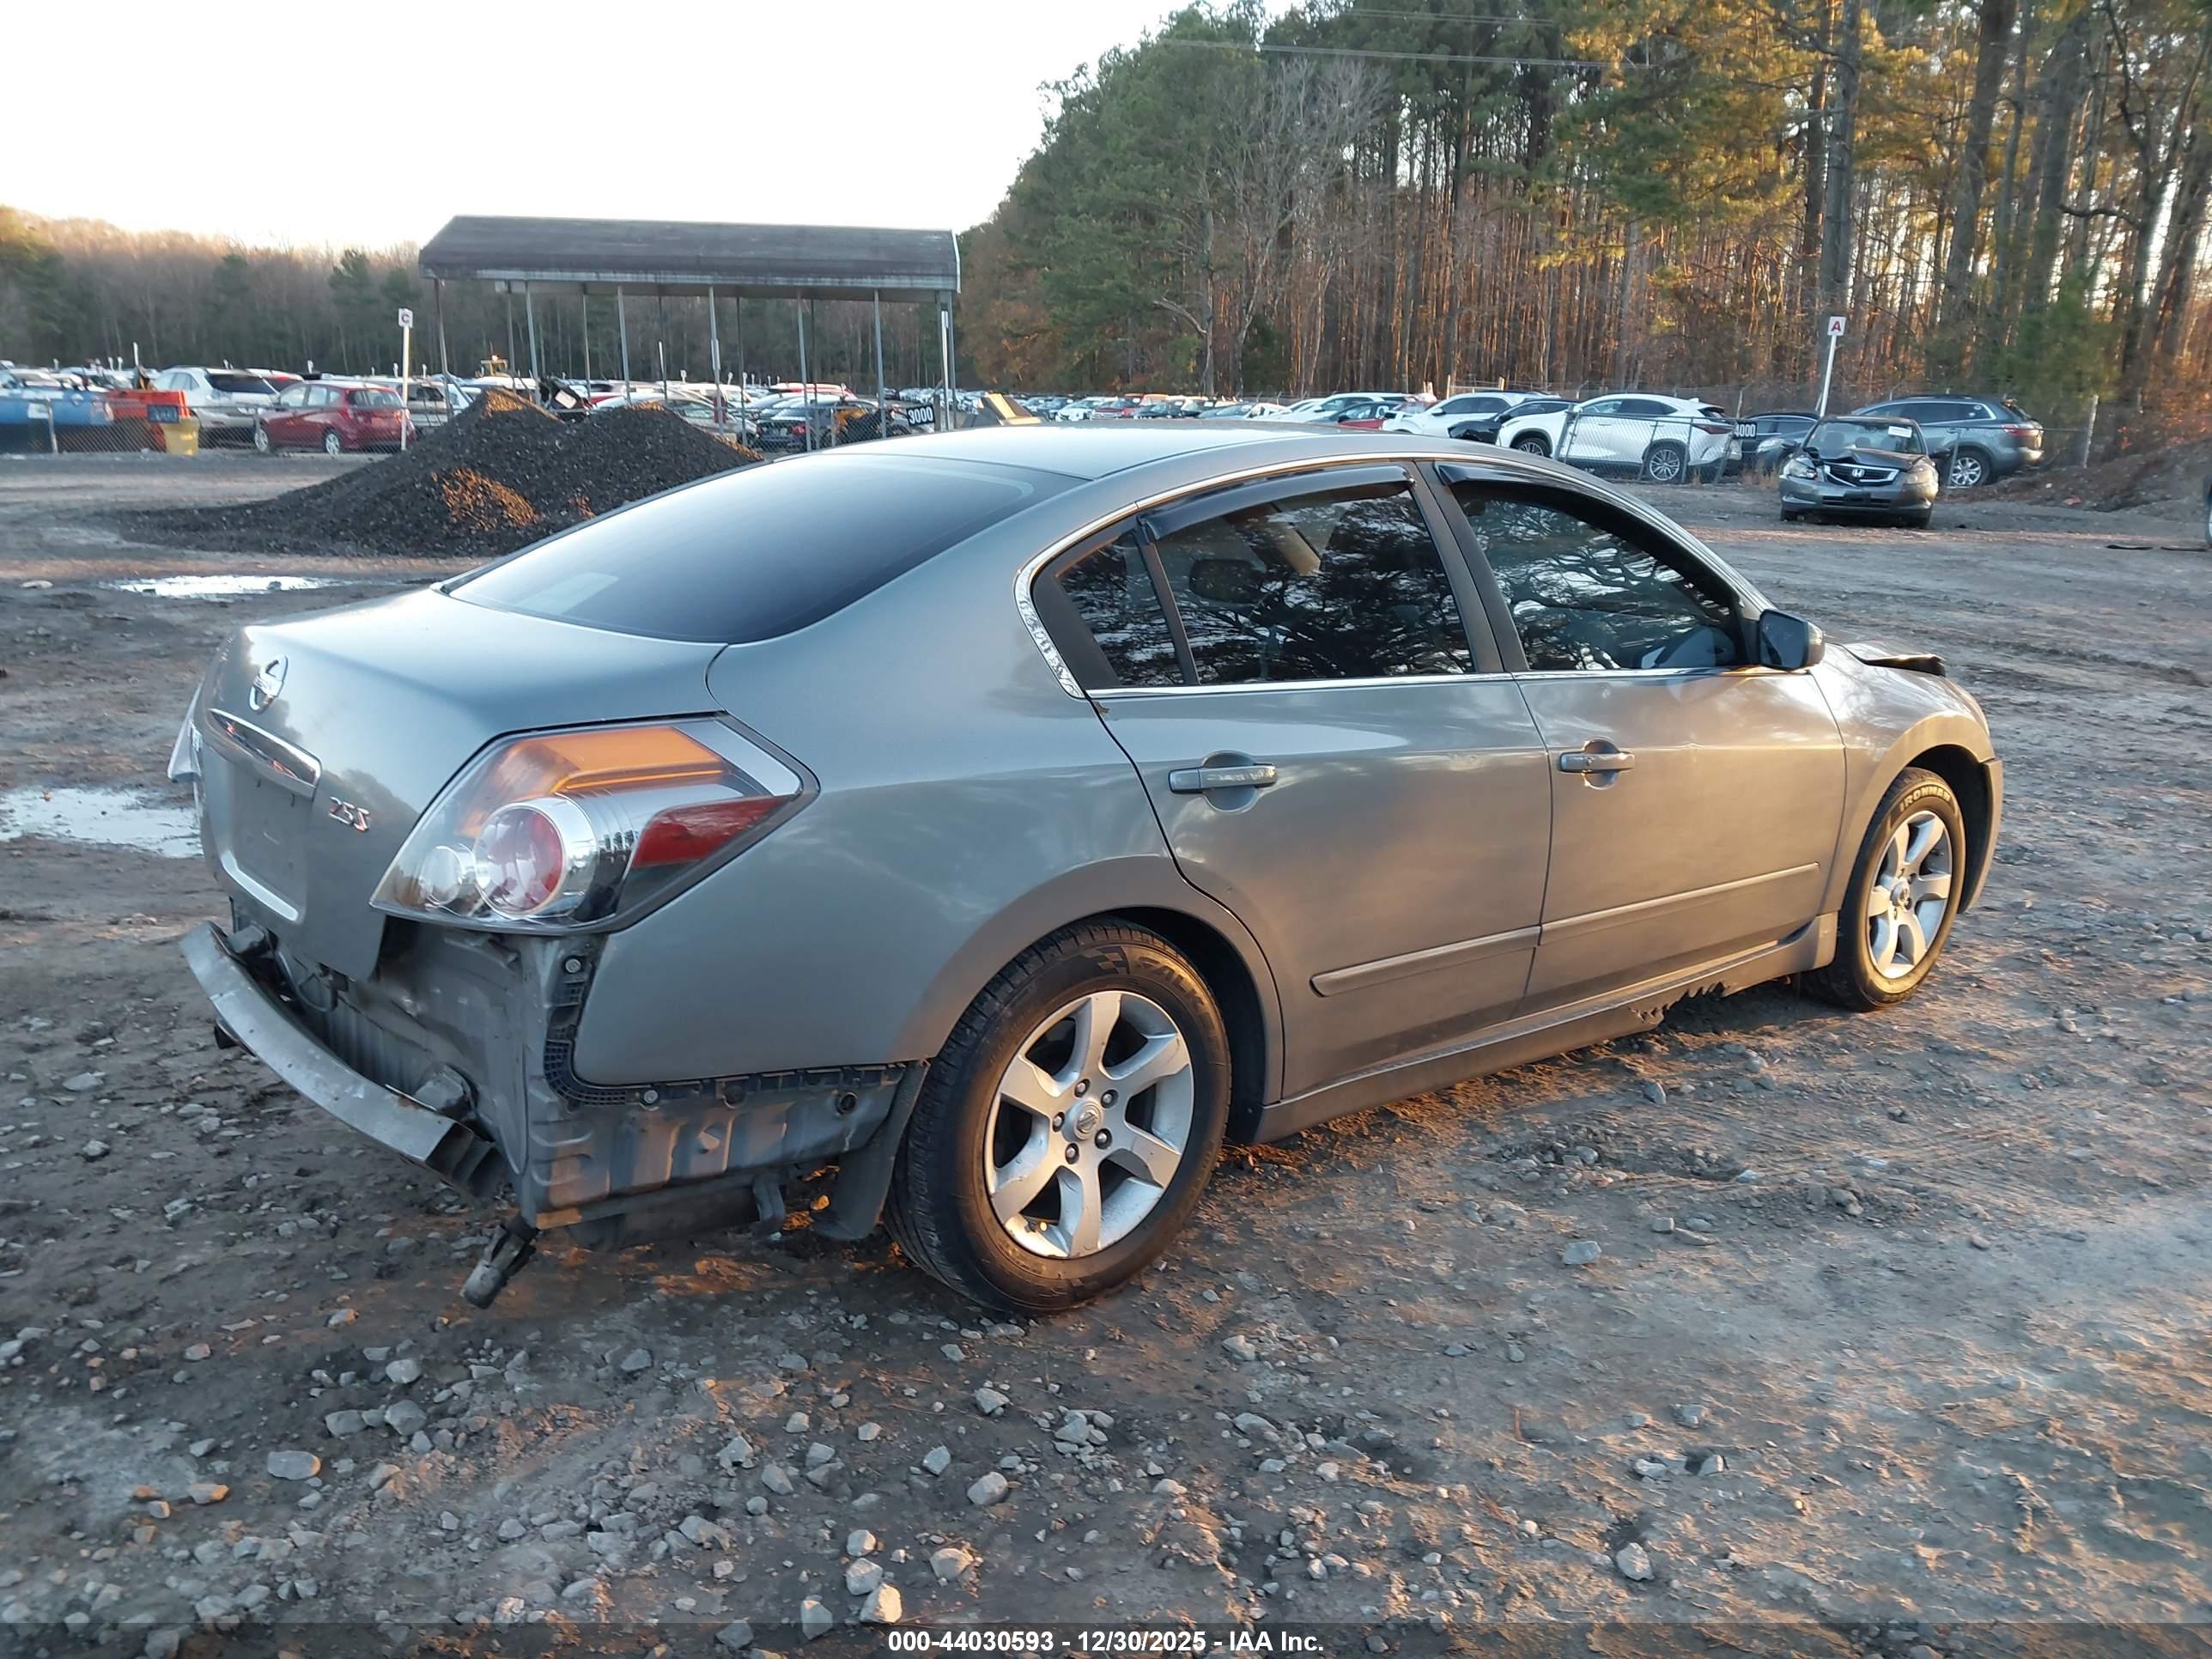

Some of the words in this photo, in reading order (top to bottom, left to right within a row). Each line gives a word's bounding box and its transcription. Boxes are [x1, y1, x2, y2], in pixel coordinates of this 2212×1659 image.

[401, 313, 410, 324] C
[1831, 321, 1842, 331] A
[908, 406, 933, 424] 3000
